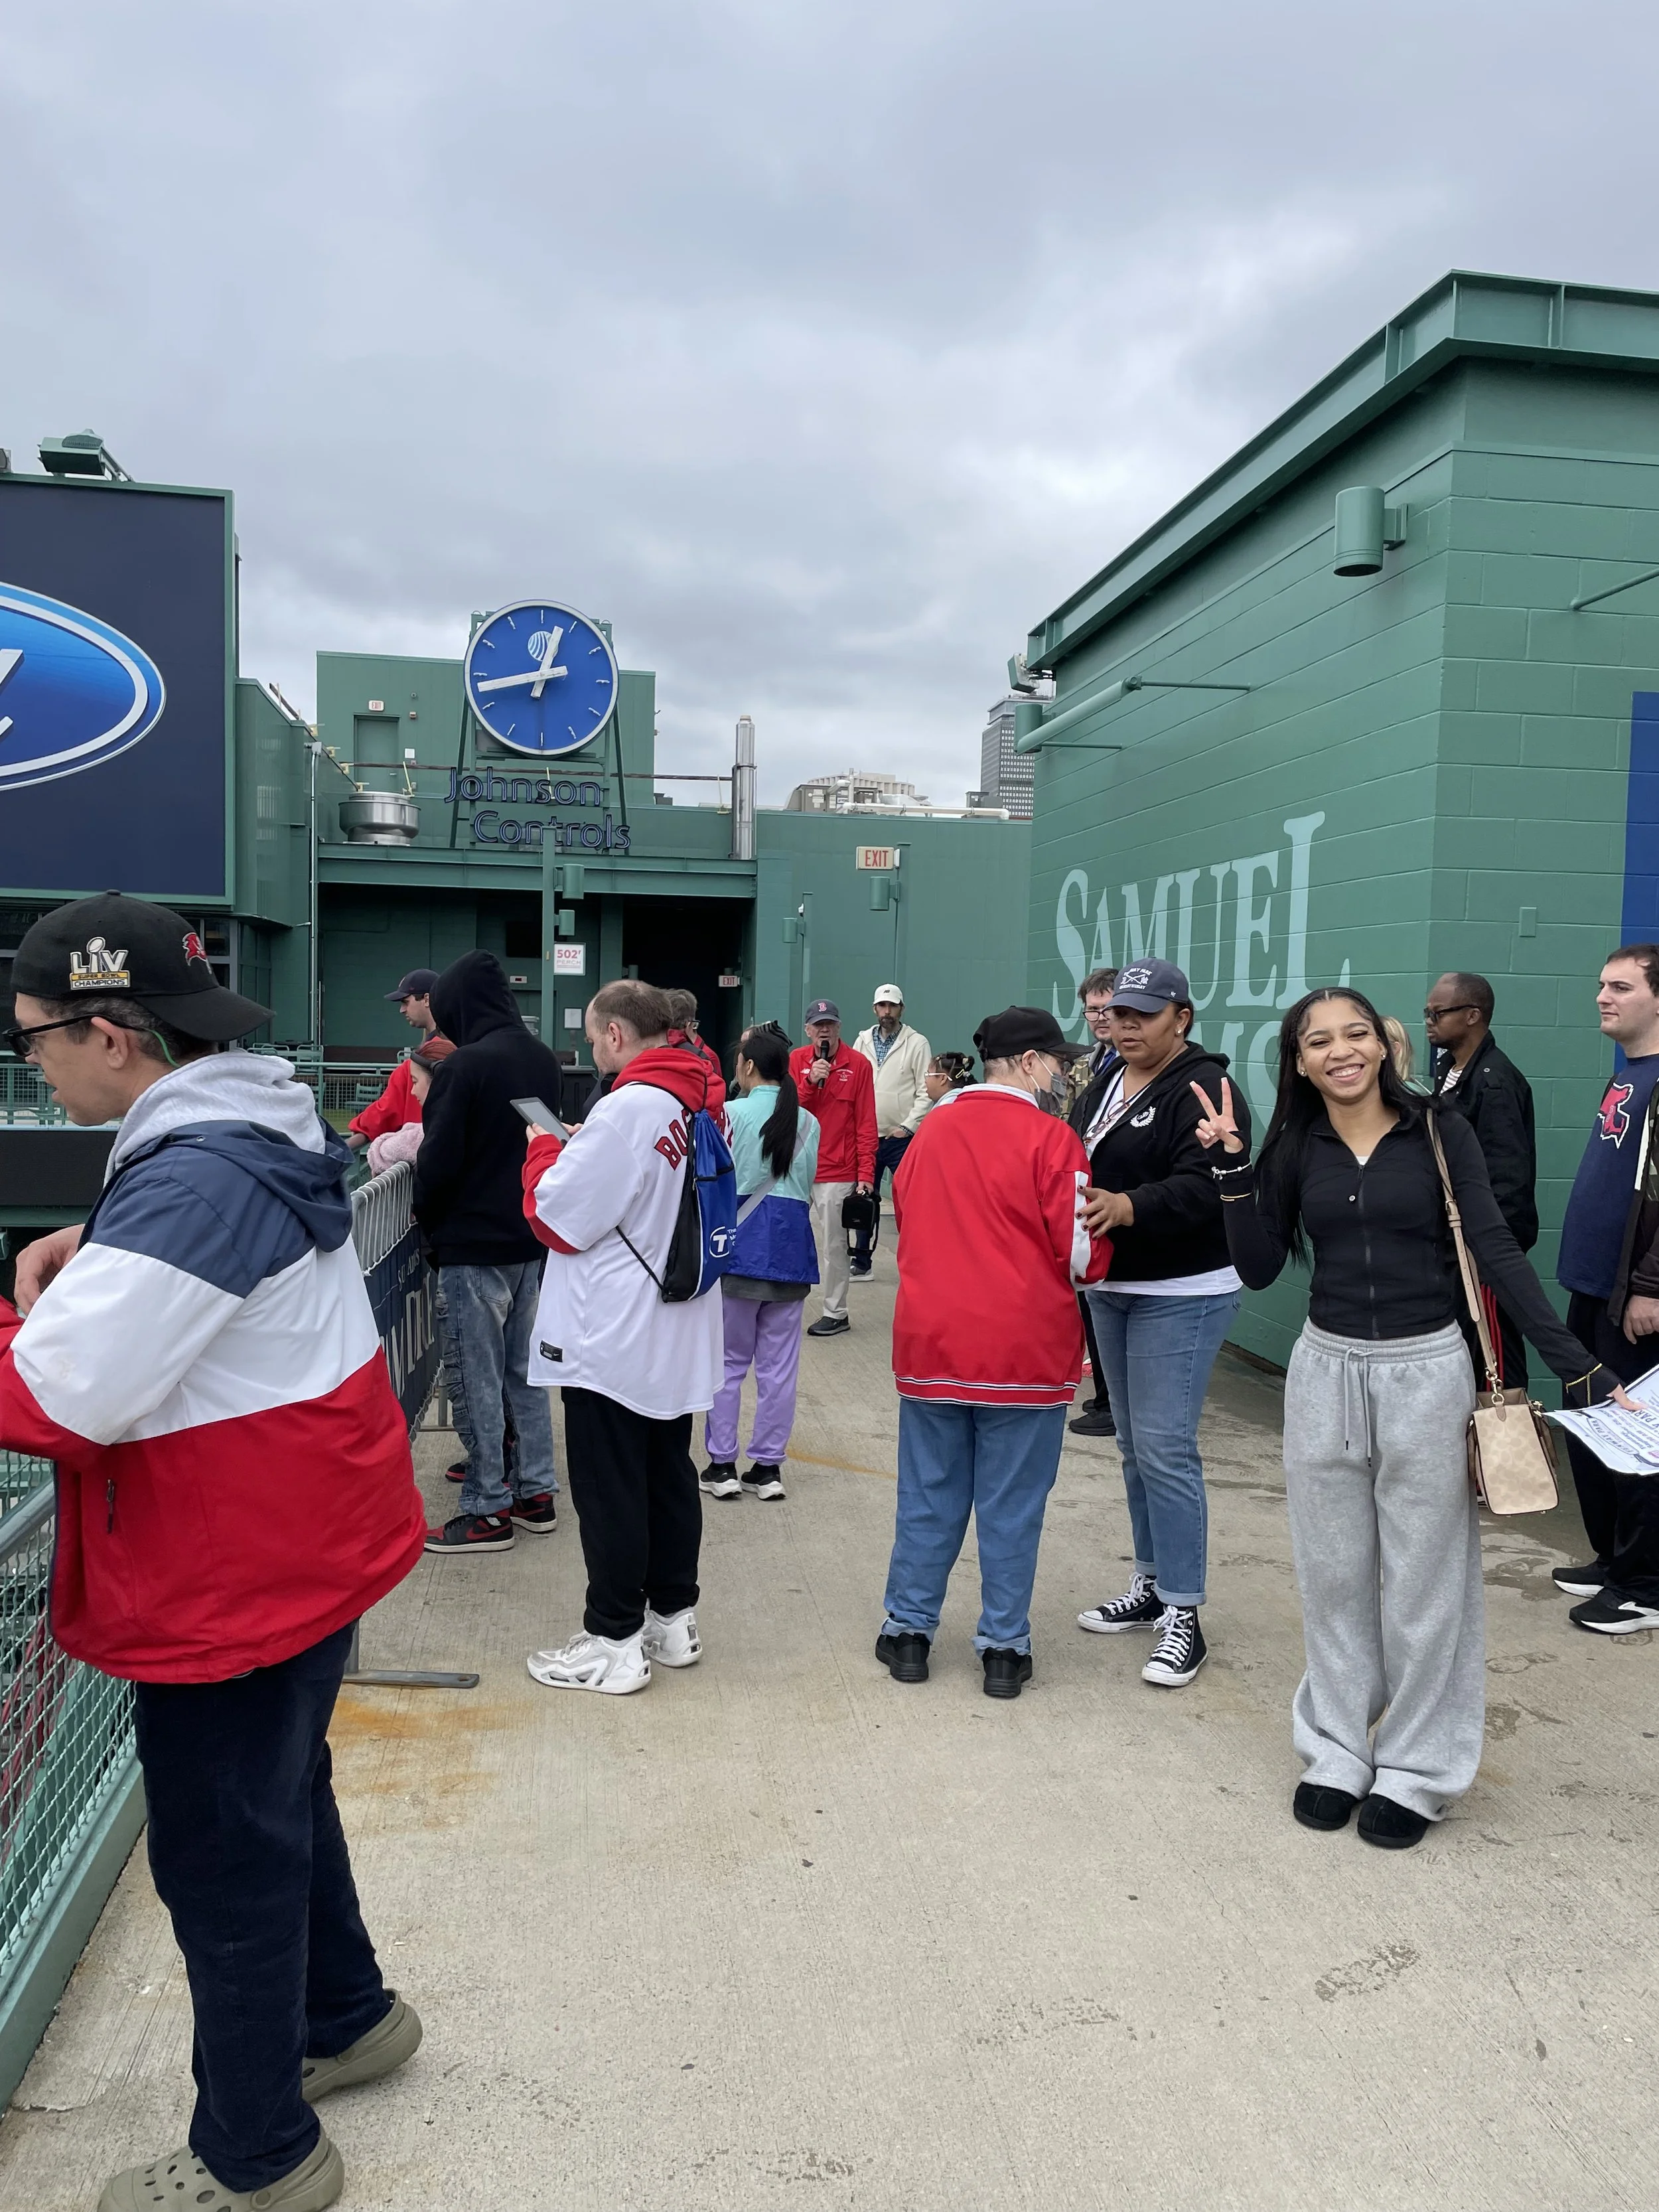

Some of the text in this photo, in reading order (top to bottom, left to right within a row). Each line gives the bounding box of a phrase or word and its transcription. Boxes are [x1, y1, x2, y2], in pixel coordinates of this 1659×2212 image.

[445, 767, 600, 807] Johnson
[474, 810, 630, 849] Controls
[865, 850, 889, 867] EXIT
[1051, 811, 1350, 1033] SAMUEL
[71, 950, 128, 974] LIV
[557, 949, 581, 958] 502'
[713, 1234, 727, 1252] T
